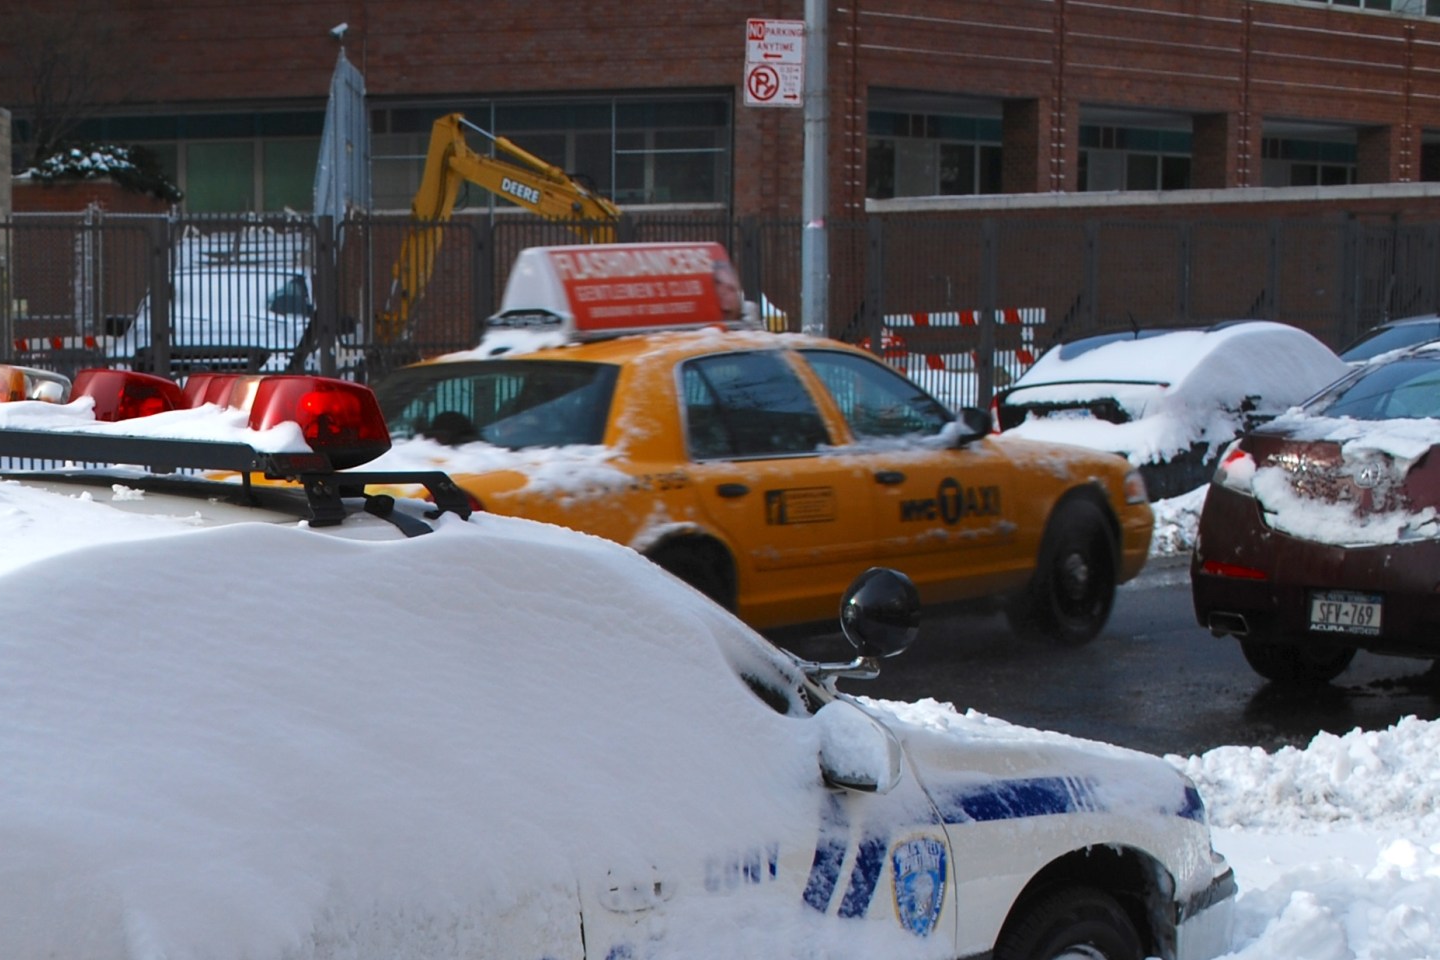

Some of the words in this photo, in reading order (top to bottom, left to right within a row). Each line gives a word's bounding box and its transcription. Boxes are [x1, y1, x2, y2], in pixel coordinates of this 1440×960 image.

[748, 22, 764, 39] NO
[766, 27, 804, 37] PARKING
[757, 42, 795, 52] ANYTIME
[501, 177, 540, 204] DEERE
[1310, 624, 1345, 632] ACURA
